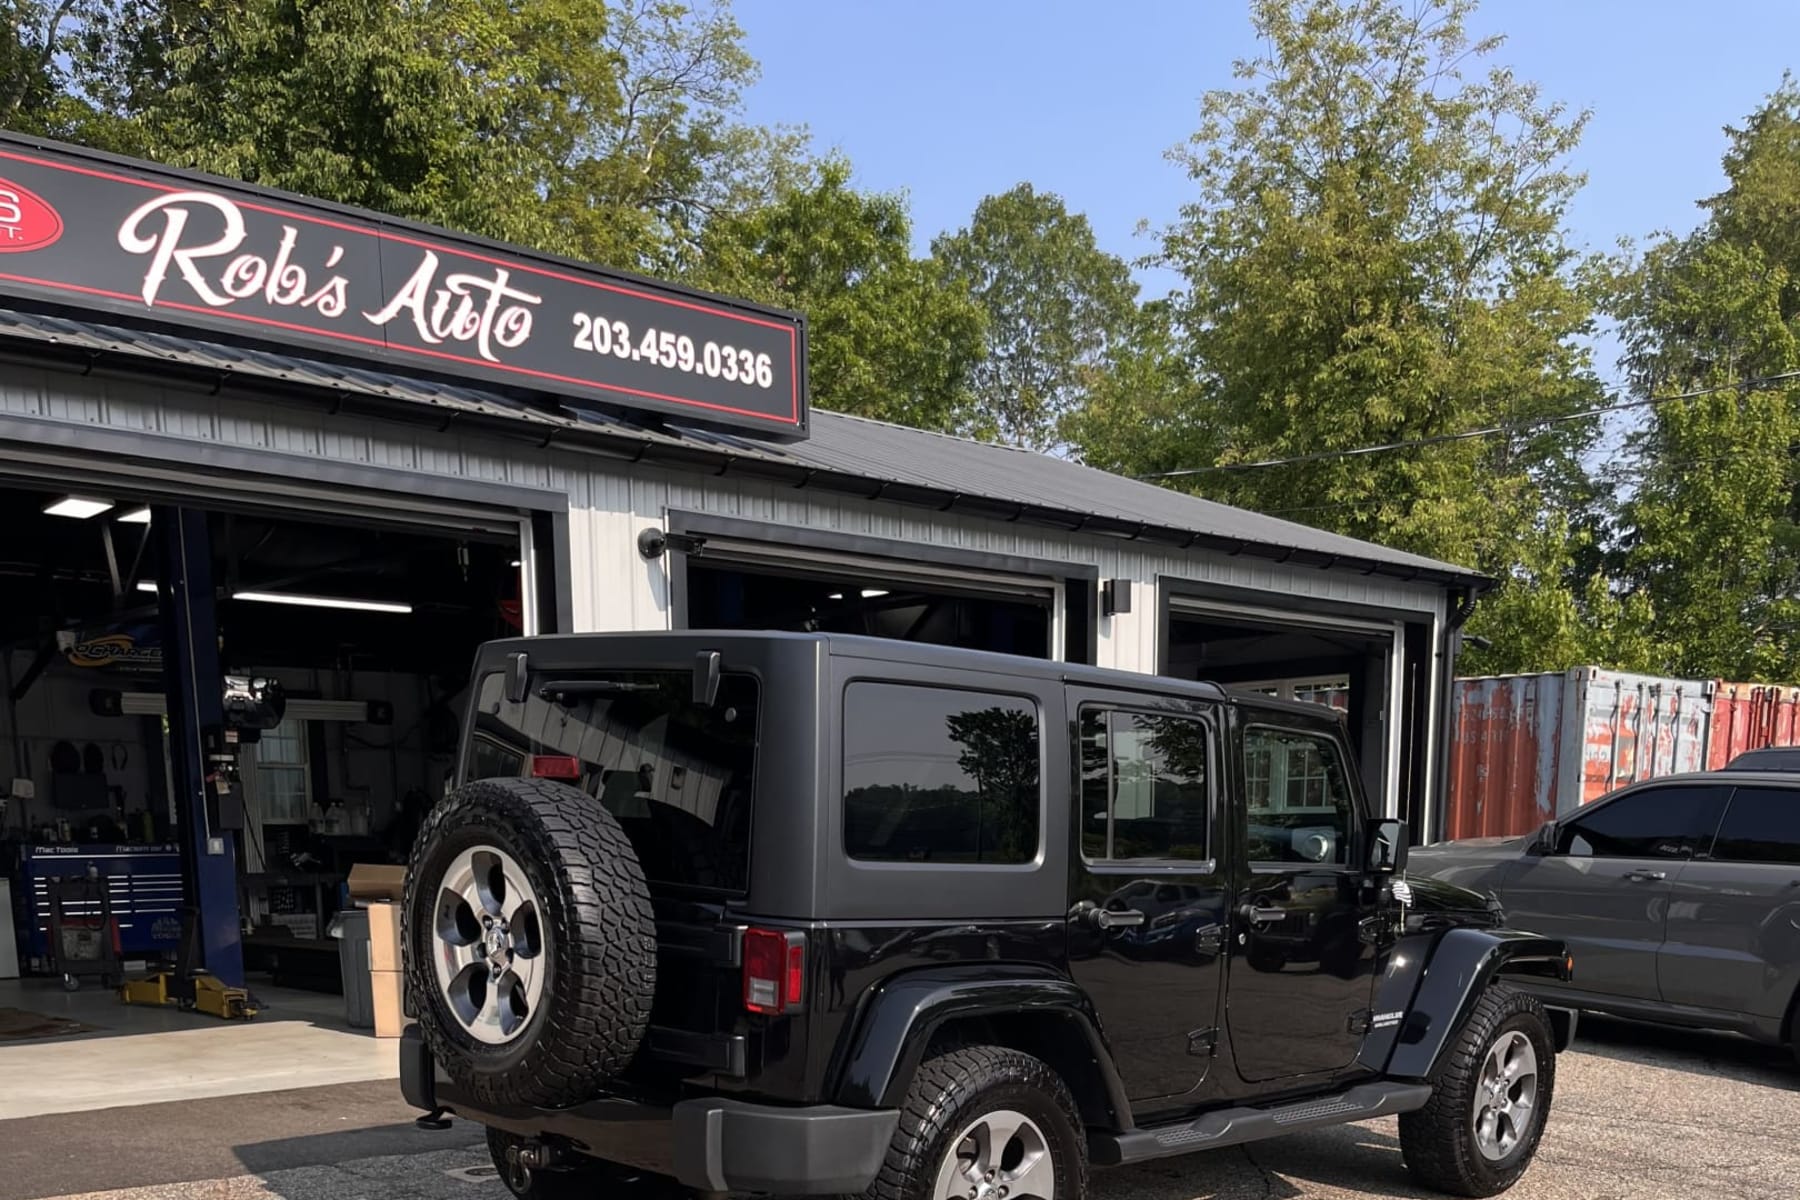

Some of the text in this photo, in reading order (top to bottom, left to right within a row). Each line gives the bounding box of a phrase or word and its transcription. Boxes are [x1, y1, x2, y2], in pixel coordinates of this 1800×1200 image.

[117, 190, 543, 363] Rob's Auto
[572, 311, 774, 389] 203.459.0336
